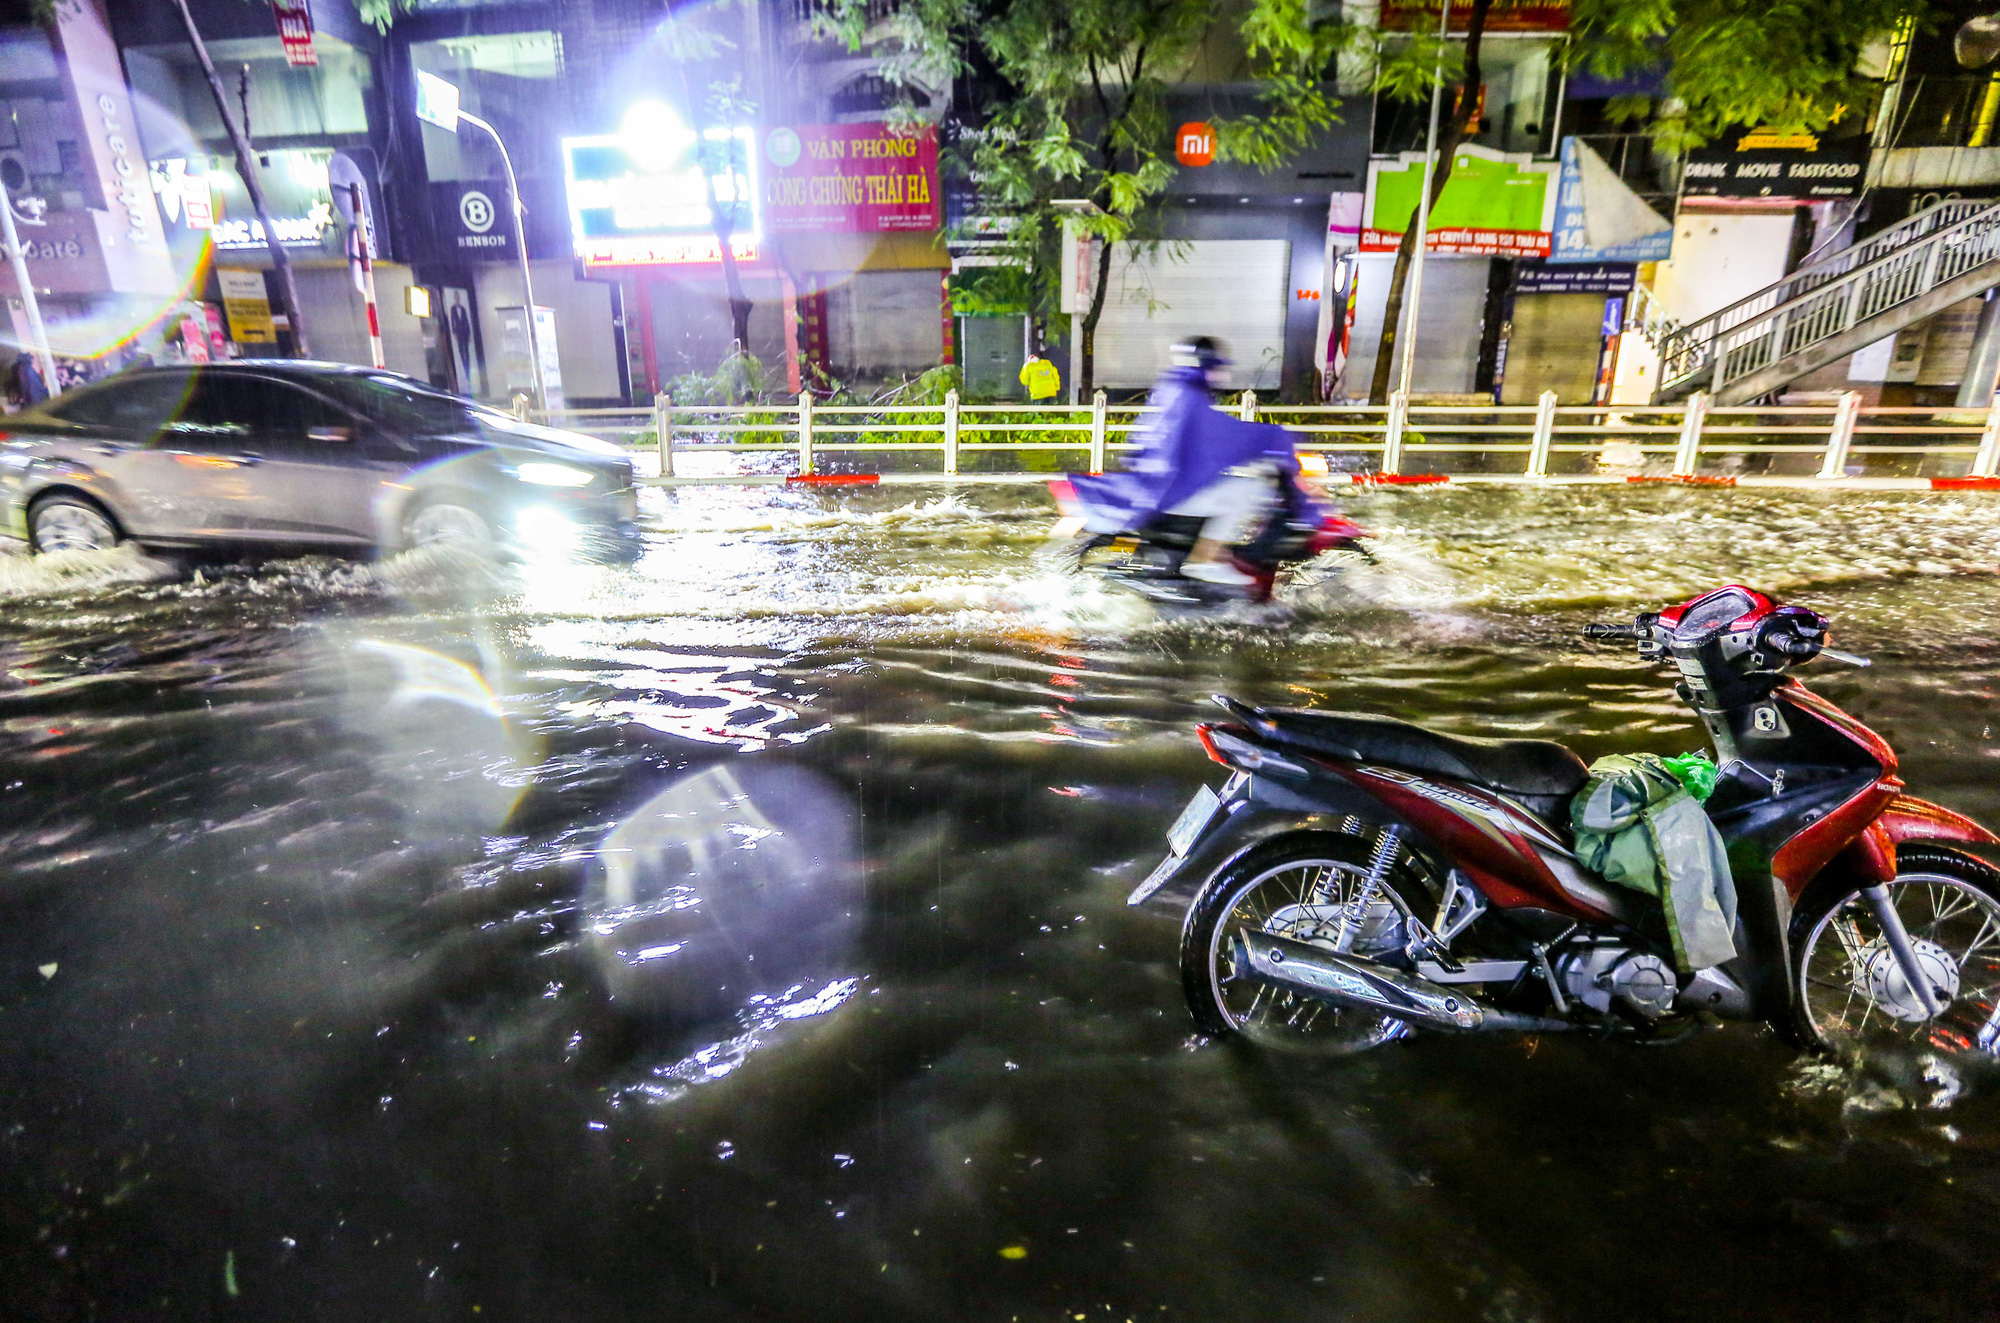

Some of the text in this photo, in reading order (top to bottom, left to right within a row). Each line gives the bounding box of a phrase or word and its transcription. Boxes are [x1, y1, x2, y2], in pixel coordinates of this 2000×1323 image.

[808, 131, 917, 159] VĂN PHÒNG
[99, 93, 149, 244] tuticare
[1735, 162, 1783, 178] MOVIE
[1788, 163, 1860, 178] FASTFOOD
[810, 166, 864, 205] CHỨNG
[866, 166, 904, 204] THÁI
[907, 165, 931, 204] HÀ
[458, 235, 506, 248] BENSON
